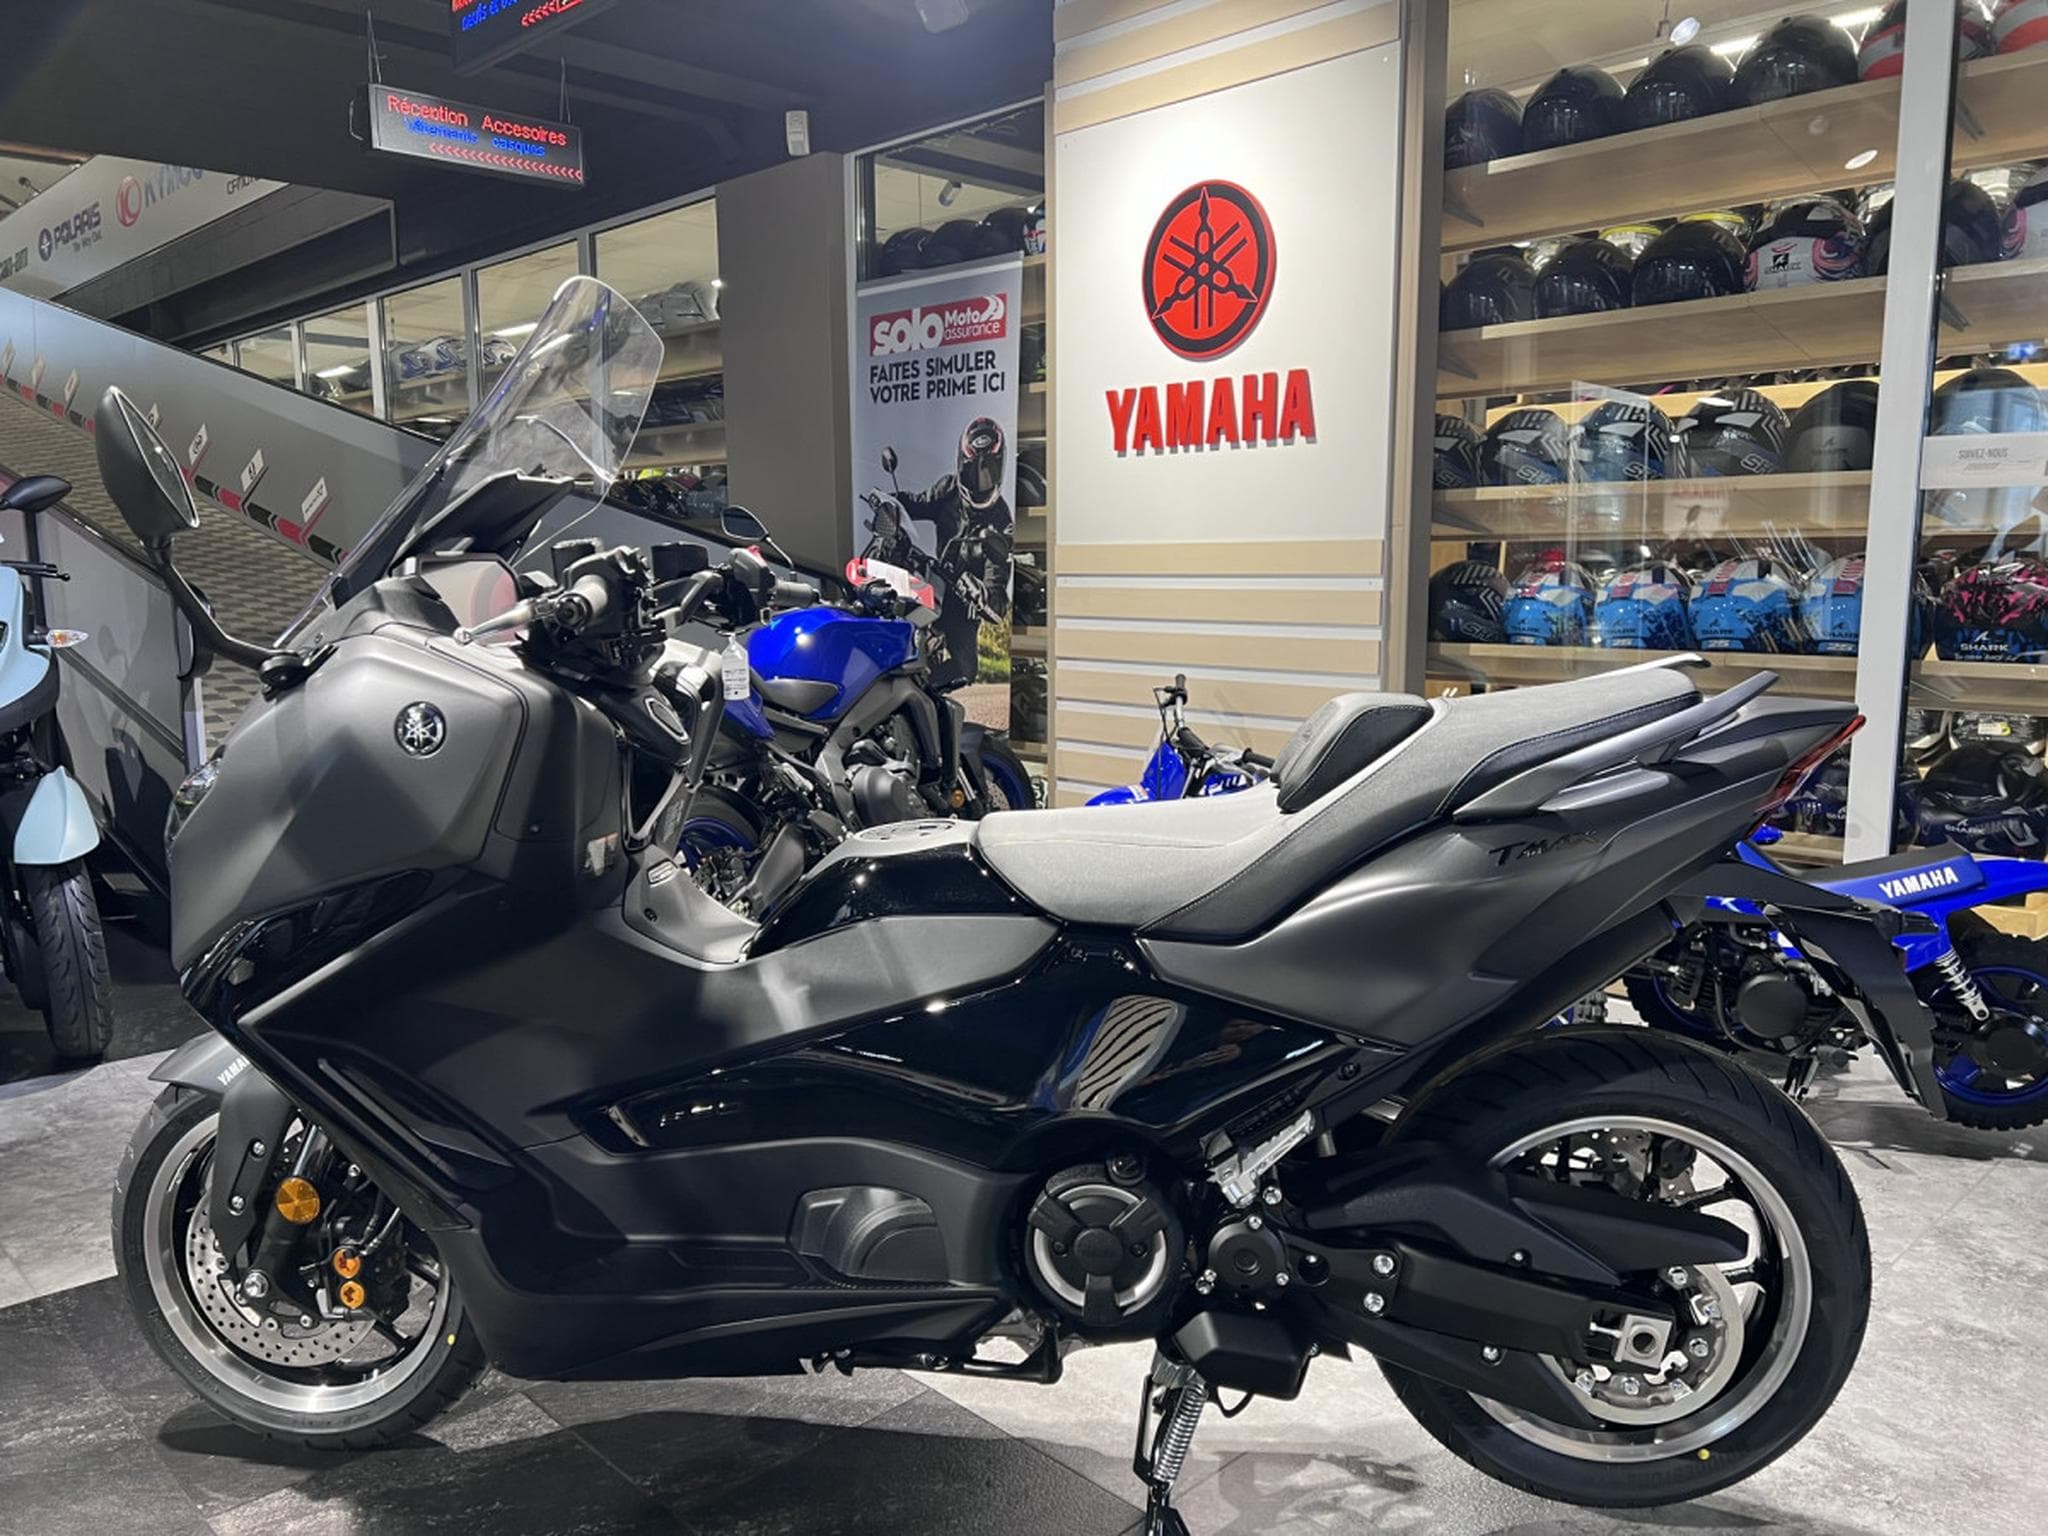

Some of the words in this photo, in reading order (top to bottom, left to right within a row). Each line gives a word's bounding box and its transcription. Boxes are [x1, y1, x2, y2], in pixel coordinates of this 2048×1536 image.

[387, 95, 469, 127] Réception
[481, 115, 567, 147] Accesoires
[53, 201, 101, 250] POLARIS
[872, 308, 944, 356] solo
[945, 308, 980, 327] Moto
[944, 320, 1000, 341] assurance
[870, 360, 920, 384] FAITES
[926, 350, 996, 377] SIMULER
[870, 382, 920, 404] VOTRE
[926, 375, 976, 399] PRIME
[983, 372, 1005, 392] ICI
[1106, 369, 1316, 456] YAMAHA
[1960, 643, 2009, 652] SHARK
[1878, 866, 1959, 899] YAMAHA
[216, 1054, 251, 1086] YAMA
